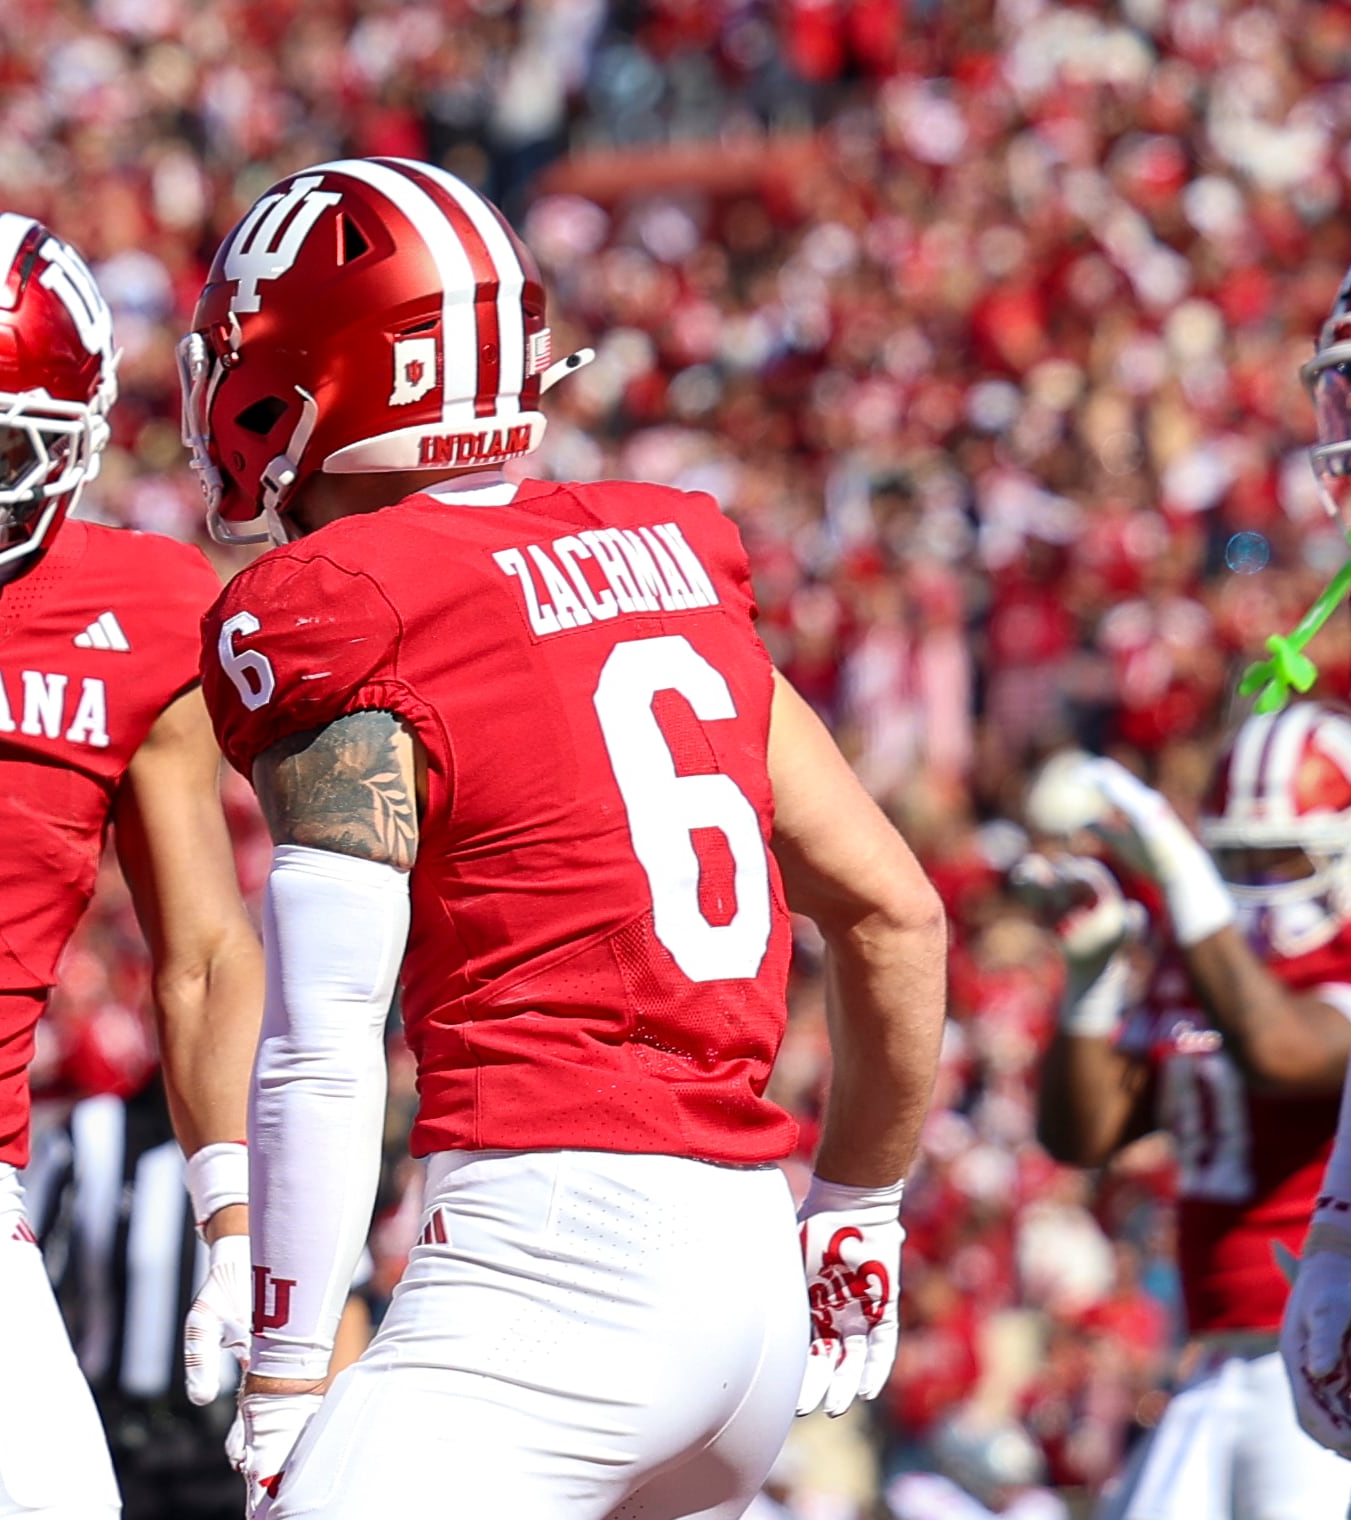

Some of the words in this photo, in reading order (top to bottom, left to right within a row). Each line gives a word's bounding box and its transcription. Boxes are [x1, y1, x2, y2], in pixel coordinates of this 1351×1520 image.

[420, 423, 532, 464] INDIAN
[492, 522, 720, 636] ZACHMAN
[218, 611, 275, 711] 6
[592, 634, 773, 983] 6
